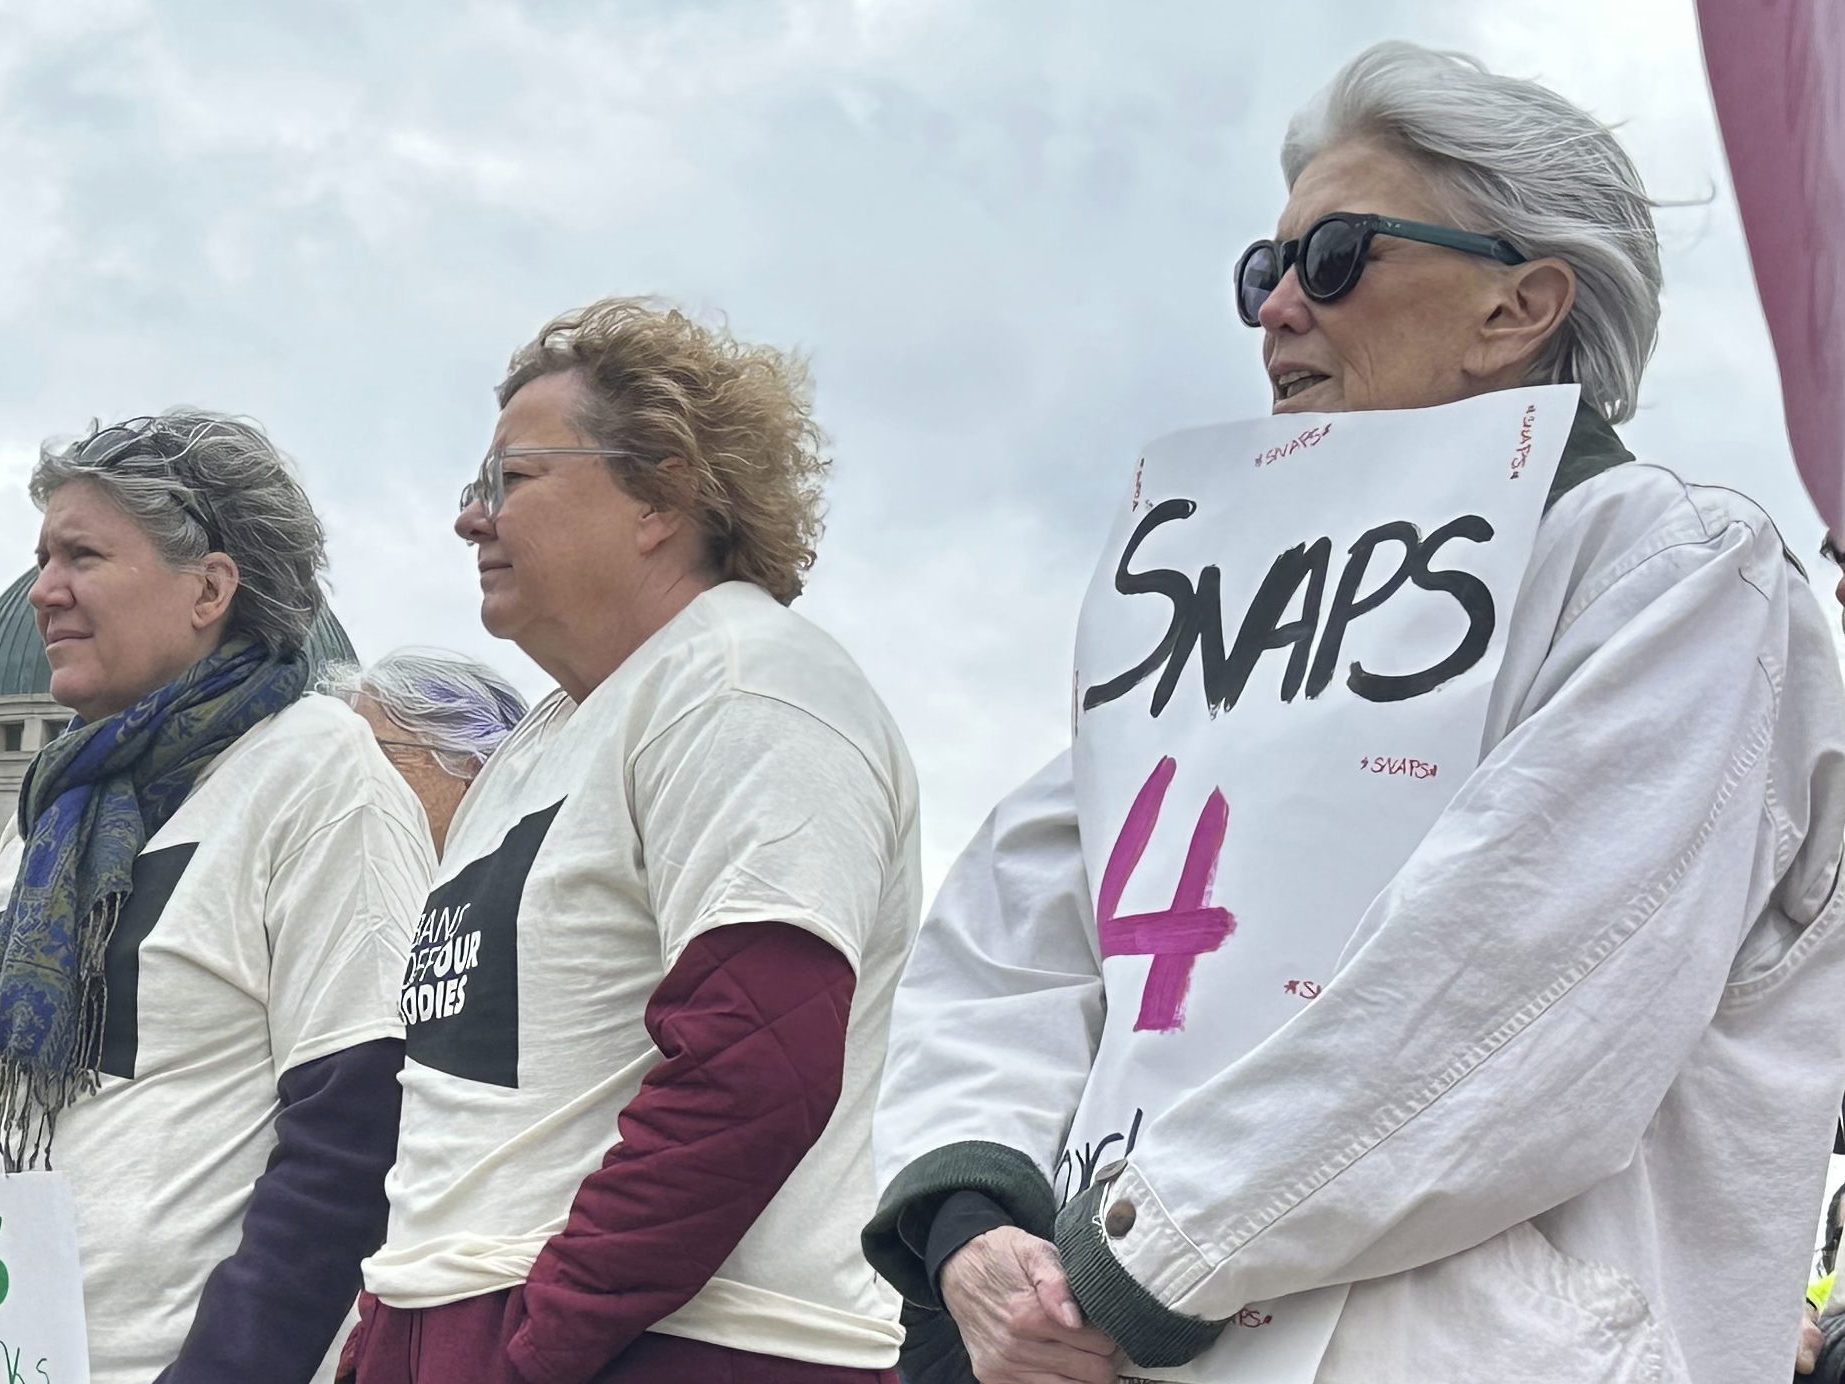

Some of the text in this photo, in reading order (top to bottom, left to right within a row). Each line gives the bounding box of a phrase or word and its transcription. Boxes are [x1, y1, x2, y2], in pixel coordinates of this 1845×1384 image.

[1083, 497, 1495, 720] SNAPS
[399, 974, 468, 1025] ODIES
[1097, 755, 1237, 1033] 4
